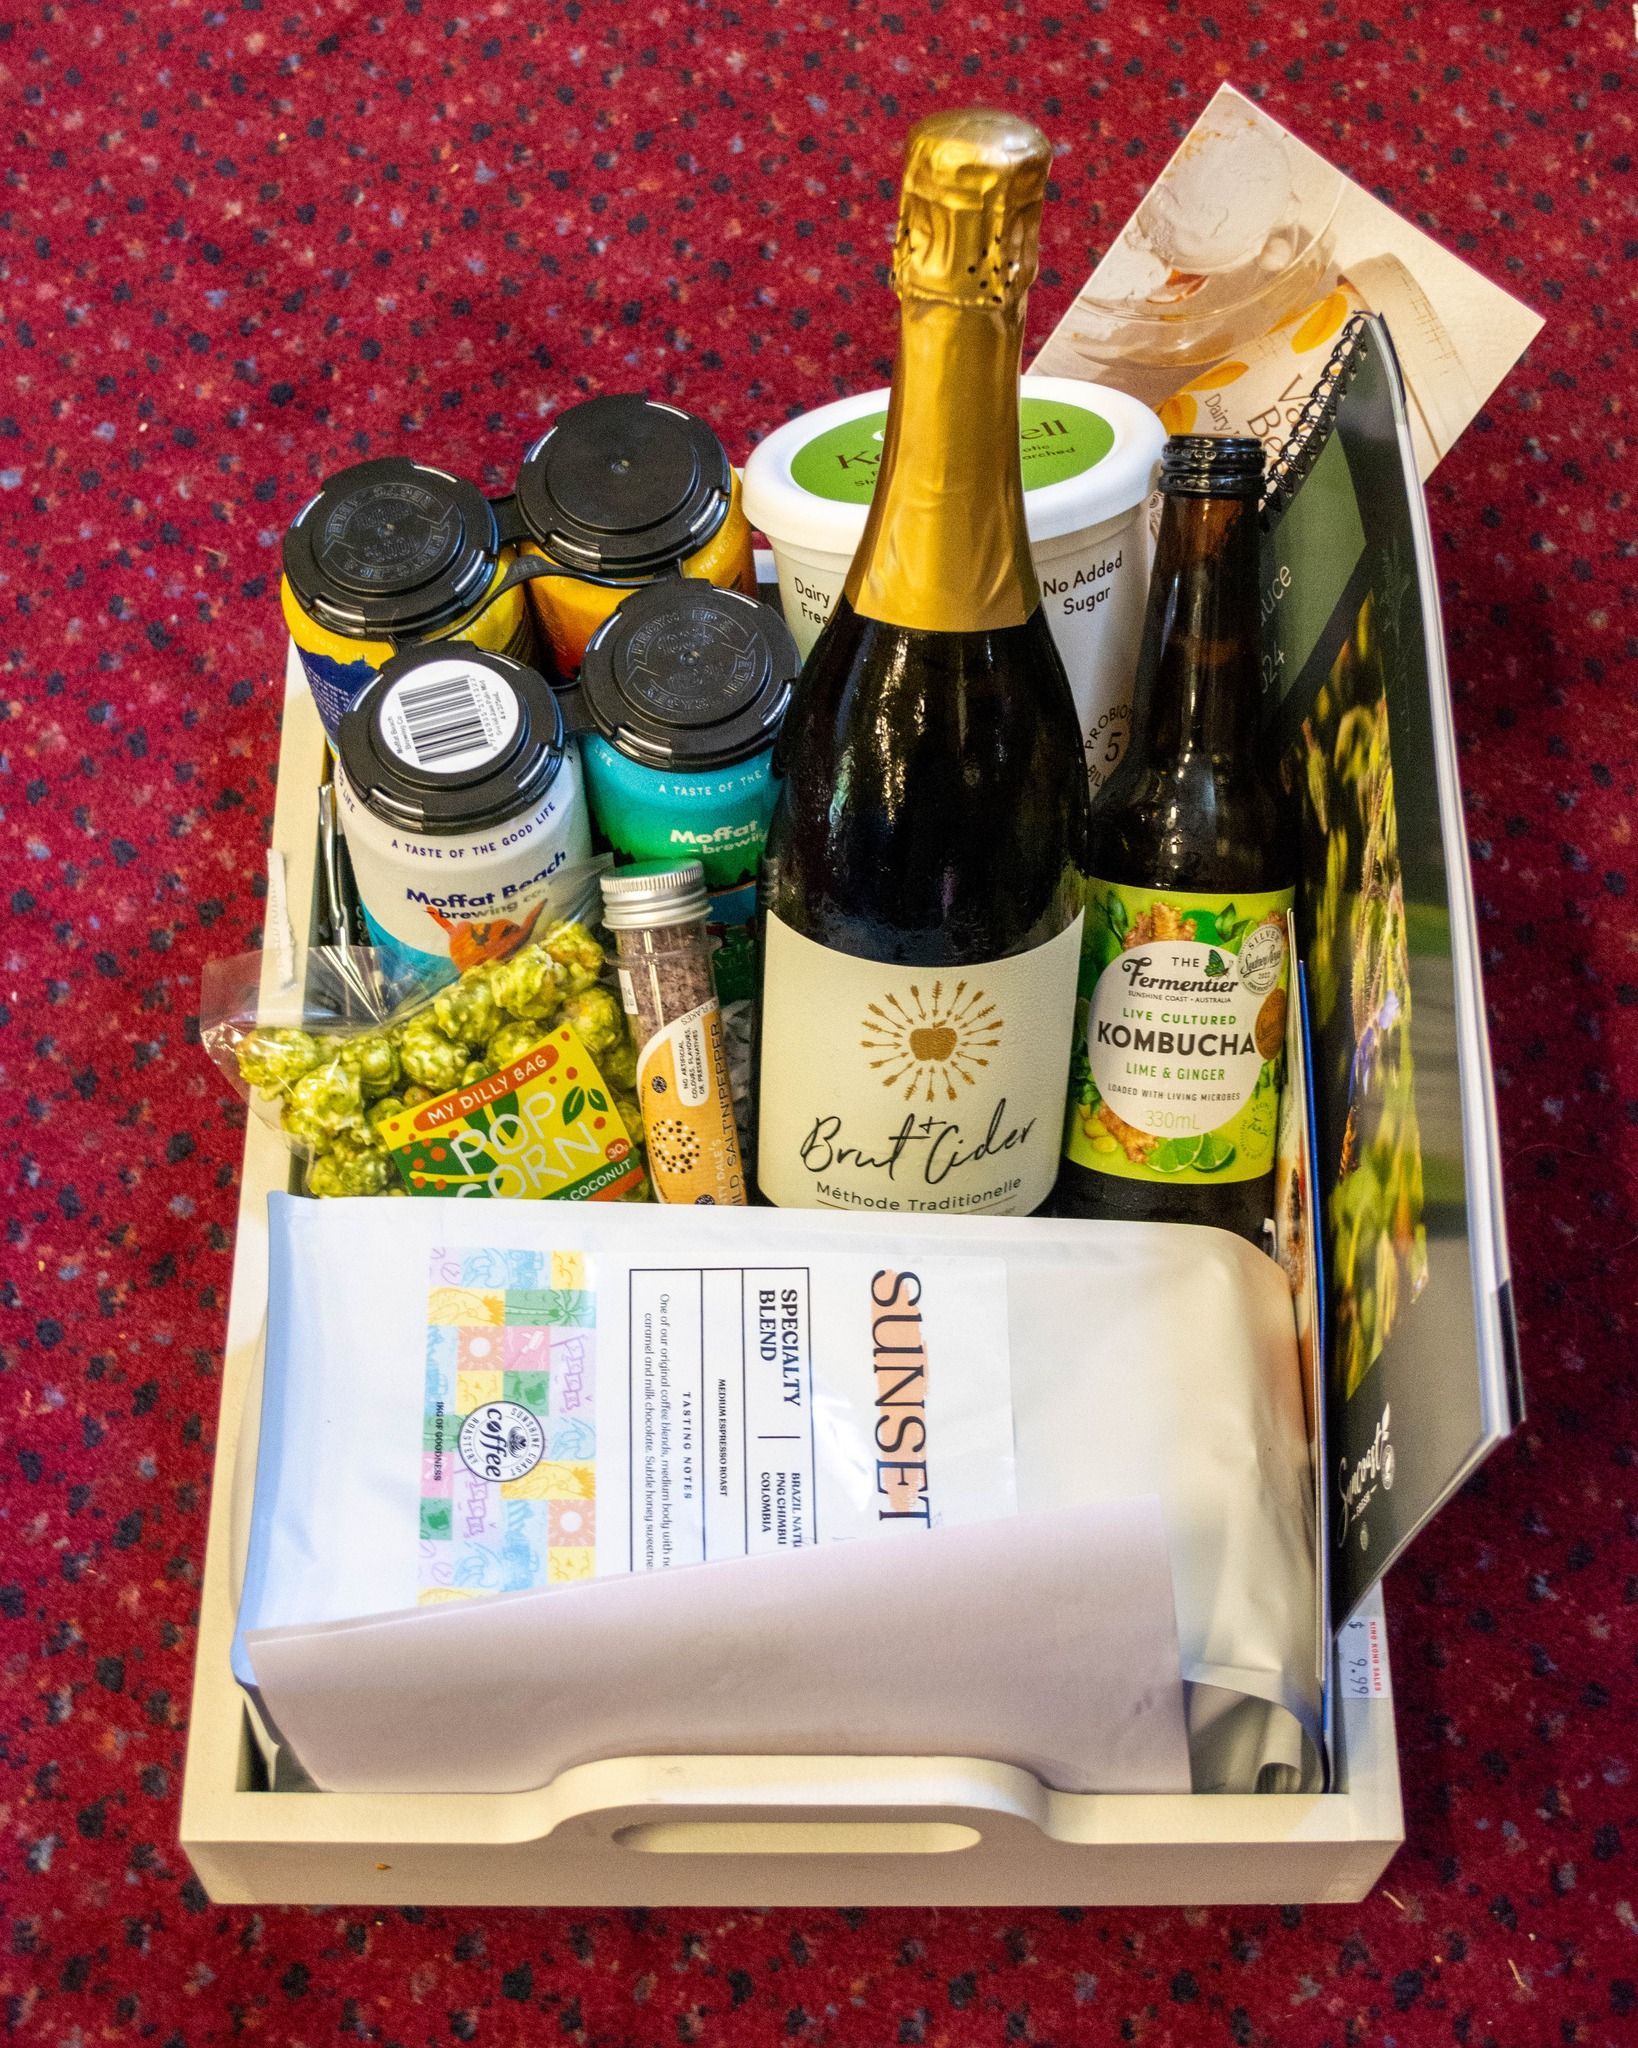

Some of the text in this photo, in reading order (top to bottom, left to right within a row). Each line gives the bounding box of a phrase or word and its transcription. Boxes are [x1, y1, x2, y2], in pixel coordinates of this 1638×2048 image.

[1204, 393, 1232, 434] Dairy
[794, 576, 831, 609] Dairy
[1042, 550, 1124, 598] No Added
[1062, 585, 1112, 616] Sugar
[1104, 731, 1122, 762] 5
[658, 771, 763, 797] A TASTE OF THE
[391, 801, 557, 859] A TASTE OF THE GOOD LIFE
[670, 819, 759, 845] Moffat
[406, 850, 568, 908] Moffat Beach
[438, 900, 519, 920] brewing
[1121, 956, 1239, 993] Fermentier
[1171, 956, 1200, 968] THE
[1128, 990, 1232, 1004] SUNSHINE COAST AUSTRALIA
[1122, 1007, 1237, 1025] LIVE CULTURED
[1097, 1020, 1256, 1057] KOMBUCHA
[677, 1040, 690, 1090] NO ARTIFICIAL
[692, 1028, 706, 1095] OR PRESERVATIVES
[1126, 1061, 1225, 1082] LIME & GINGER
[428, 1053, 549, 1126] MY DILLY BAG
[1107, 1082, 1241, 1102] LOADED WITH LIVING MICROBES
[450, 1090, 556, 1177] POP
[1144, 1108, 1200, 1130] 330mL
[800, 1097, 1037, 1185] Brut Cider
[570, 1158, 632, 1201] COCONUT
[816, 1180, 901, 1211] Méthode
[907, 1177, 1022, 1211] Traditionelle
[660, 1293, 670, 1314] One
[660, 1315, 671, 1327] of
[644, 1312, 656, 1355] caramel
[660, 1328, 669, 1346] our
[758, 1289, 778, 1362] BLEND
[780, 1287, 801, 1408] SPECIALTY
[644, 1356, 656, 1377] and
[658, 1347, 671, 1388] original
[644, 1378, 656, 1400] milk
[660, 1389, 671, 1421] coffee
[870, 1268, 931, 1530] SUNSET
[435, 1418, 444, 1431] OF
[462, 1417, 479, 1466] ROASTERY
[478, 1408, 508, 1478] coffee
[510, 1407, 541, 1477] SUNSHINE COAST
[660, 1421, 672, 1458] blends,
[717, 1378, 729, 1497] MEDIUM ESPRESSO ROAST
[433, 1431, 444, 1481] GOODNESS
[682, 1391, 693, 1499] TASTING NOTES
[645, 1455, 656, 1489] Subtle
[661, 1459, 672, 1502] medium
[776, 1472, 786, 1496] PNG
[643, 1489, 656, 1522] honey
[659, 1502, 672, 1530] body
[761, 1471, 772, 1533] COLOMBIA
[791, 1472, 803, 1548] BRAZIL NATU
[662, 1530, 672, 1555] with
[1347, 1621, 1369, 1695] $ 9.99
